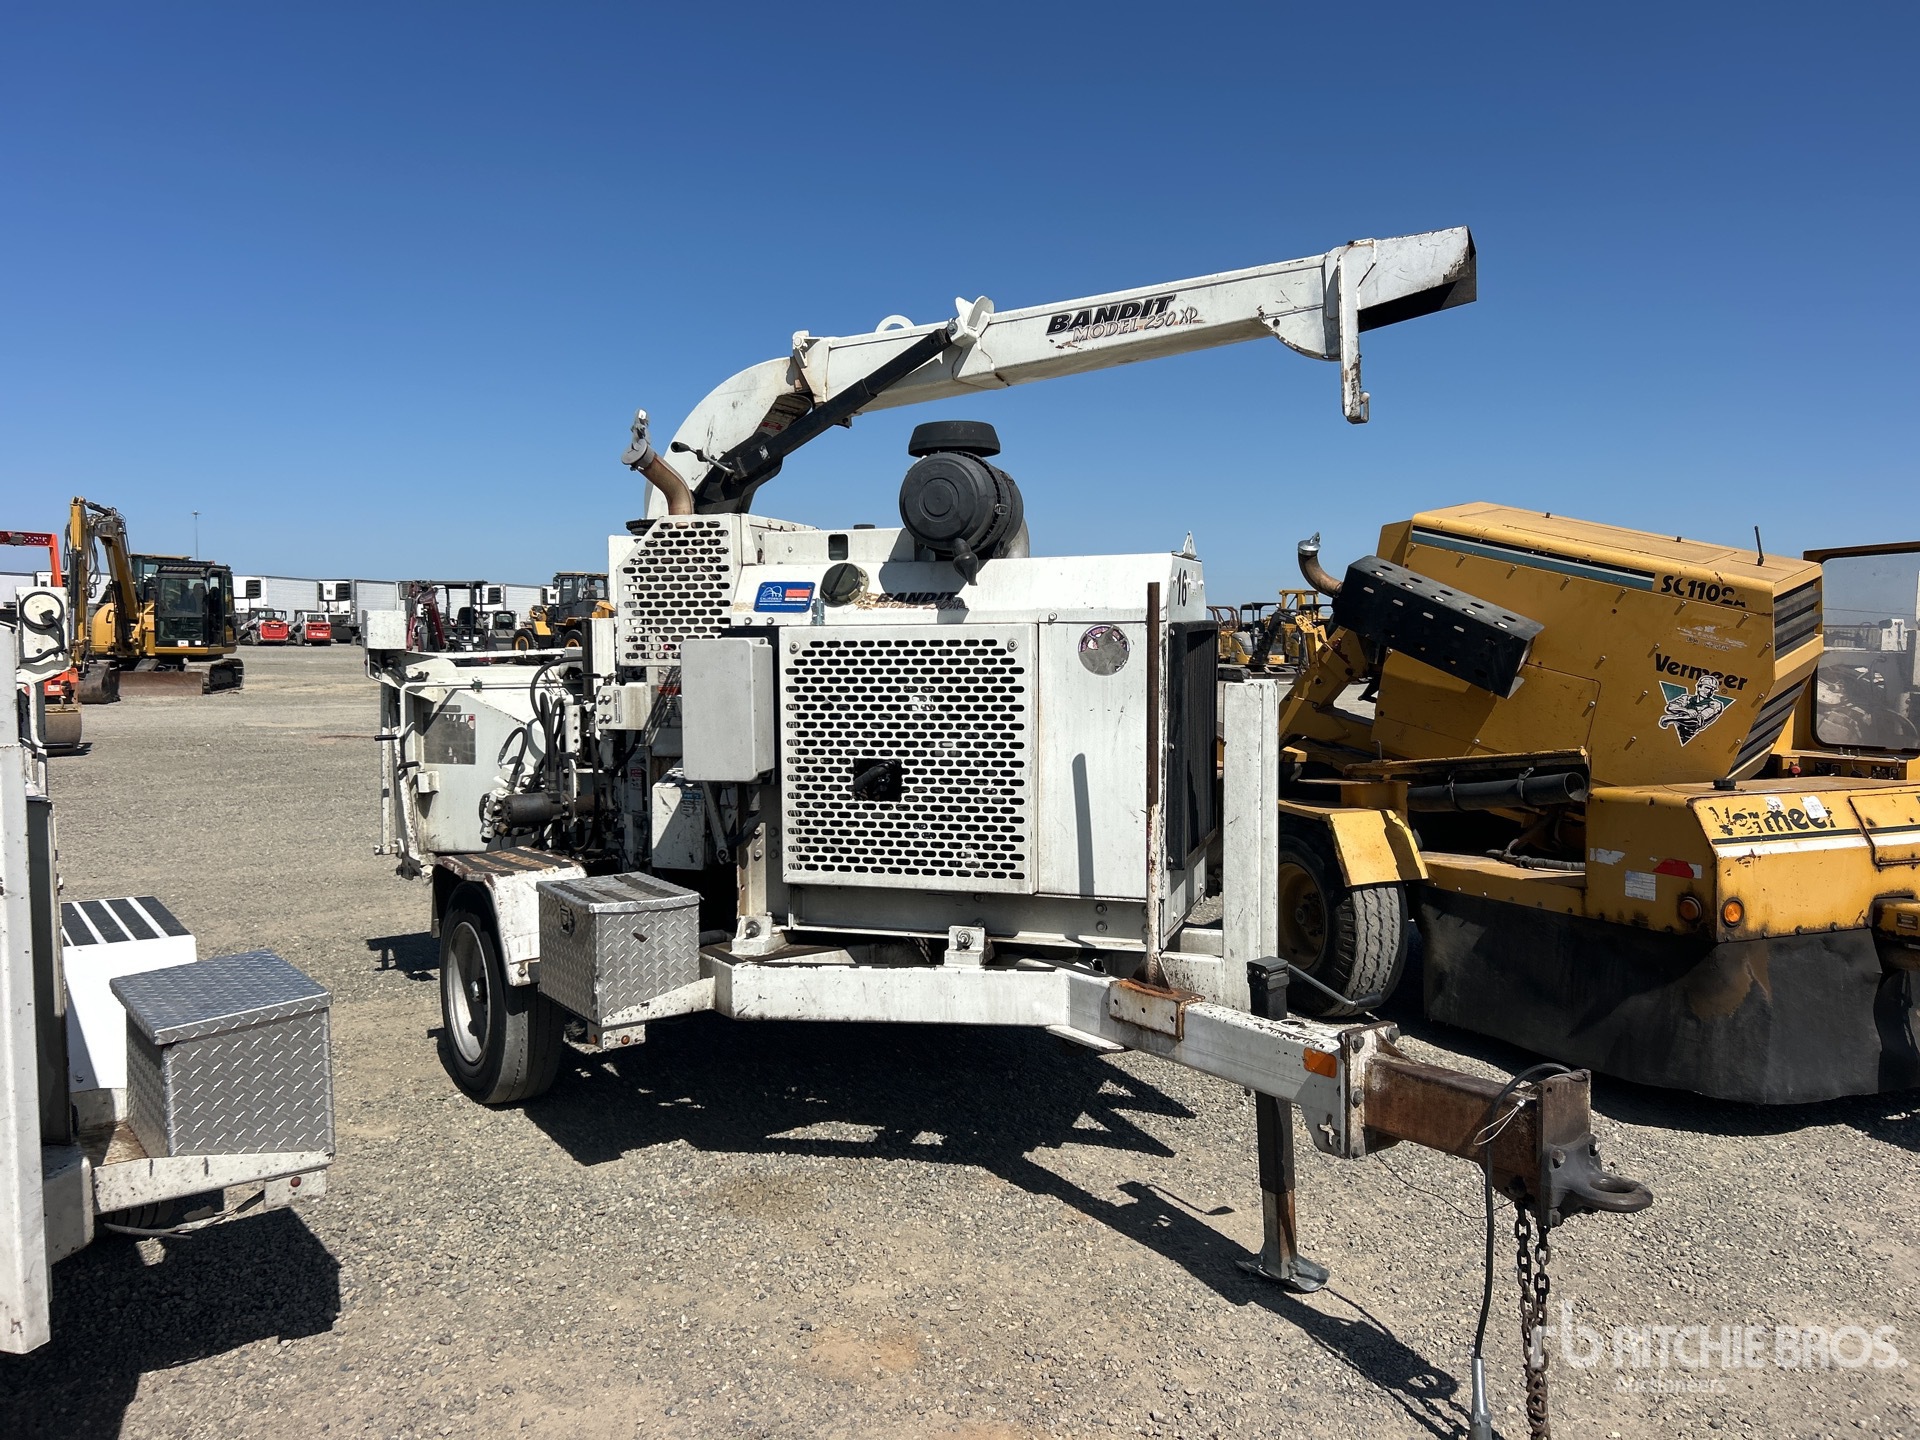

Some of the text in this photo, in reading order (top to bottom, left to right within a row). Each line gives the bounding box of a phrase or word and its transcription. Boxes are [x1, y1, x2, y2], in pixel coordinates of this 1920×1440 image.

[1046, 294, 1177, 335] BANDIT
[1072, 306, 1200, 343] MODEL 250 XP
[875, 592, 960, 604] BANDIT
[1176, 567, 1188, 607] 16
